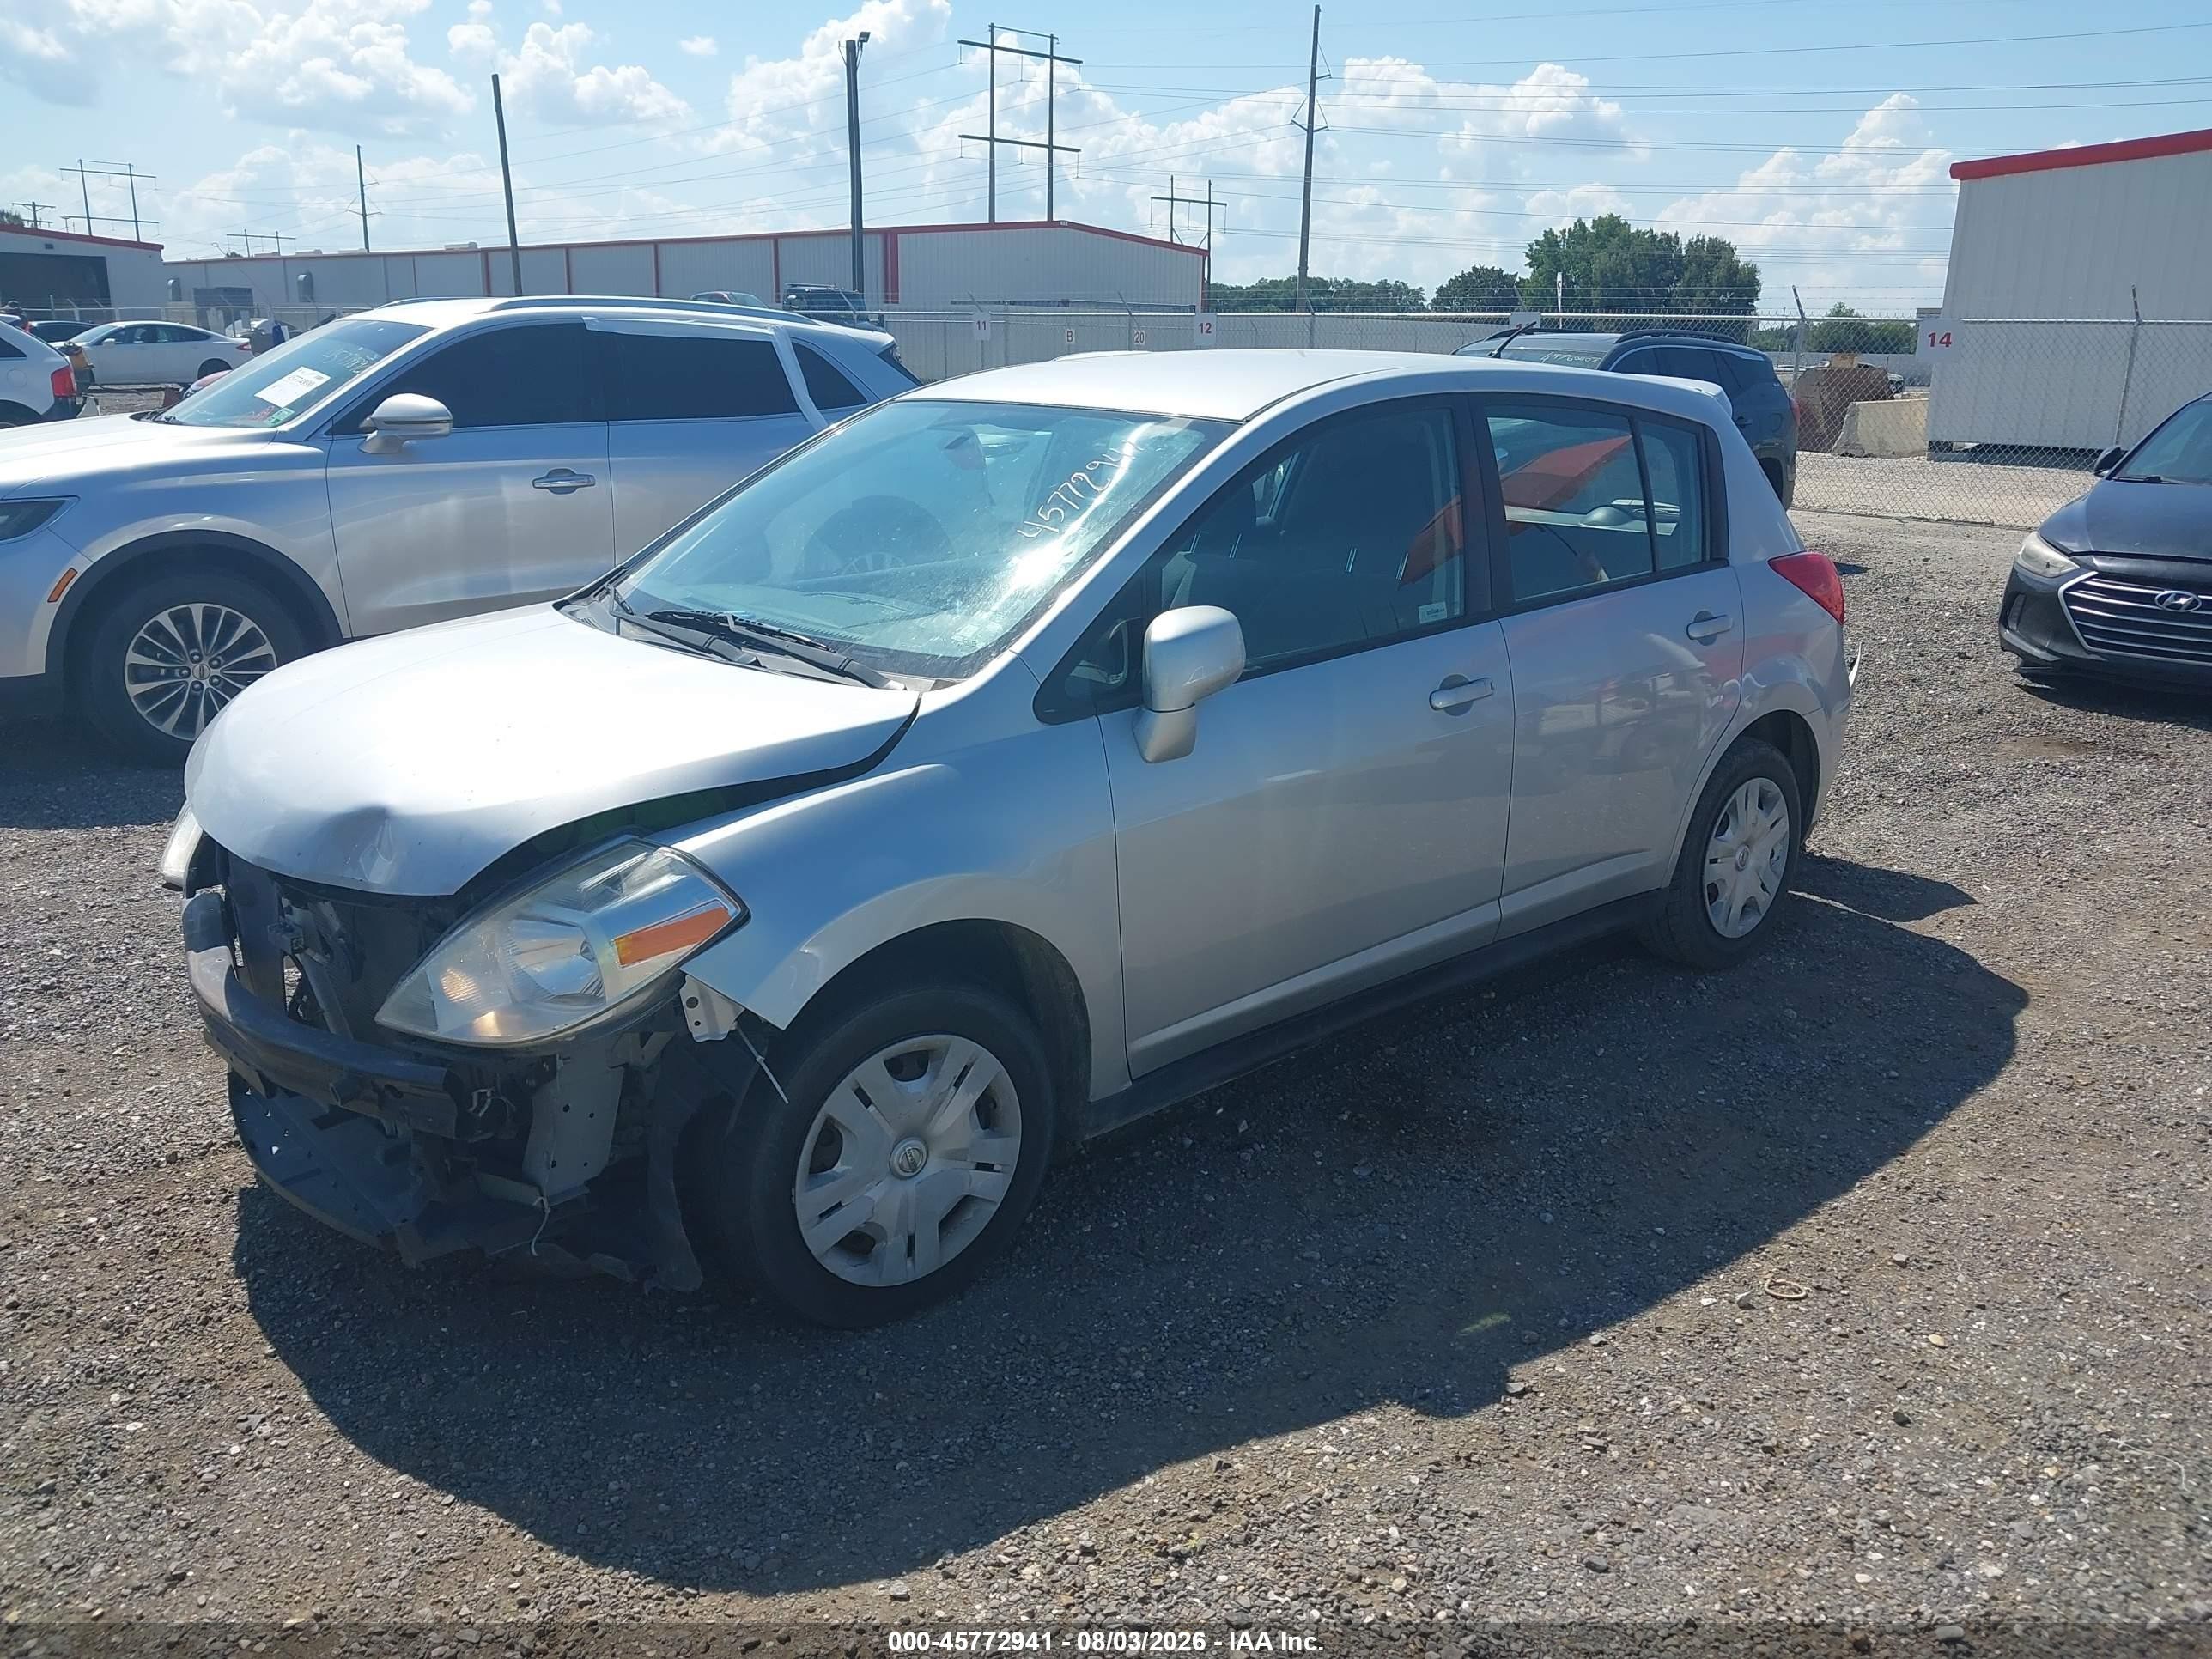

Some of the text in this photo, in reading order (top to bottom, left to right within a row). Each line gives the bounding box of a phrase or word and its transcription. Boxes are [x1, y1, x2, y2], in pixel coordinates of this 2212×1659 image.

[976, 320, 987, 331] 11
[1199, 322, 1212, 334] 12
[1134, 331, 1145, 343] 20
[1928, 331, 1952, 348] 14
